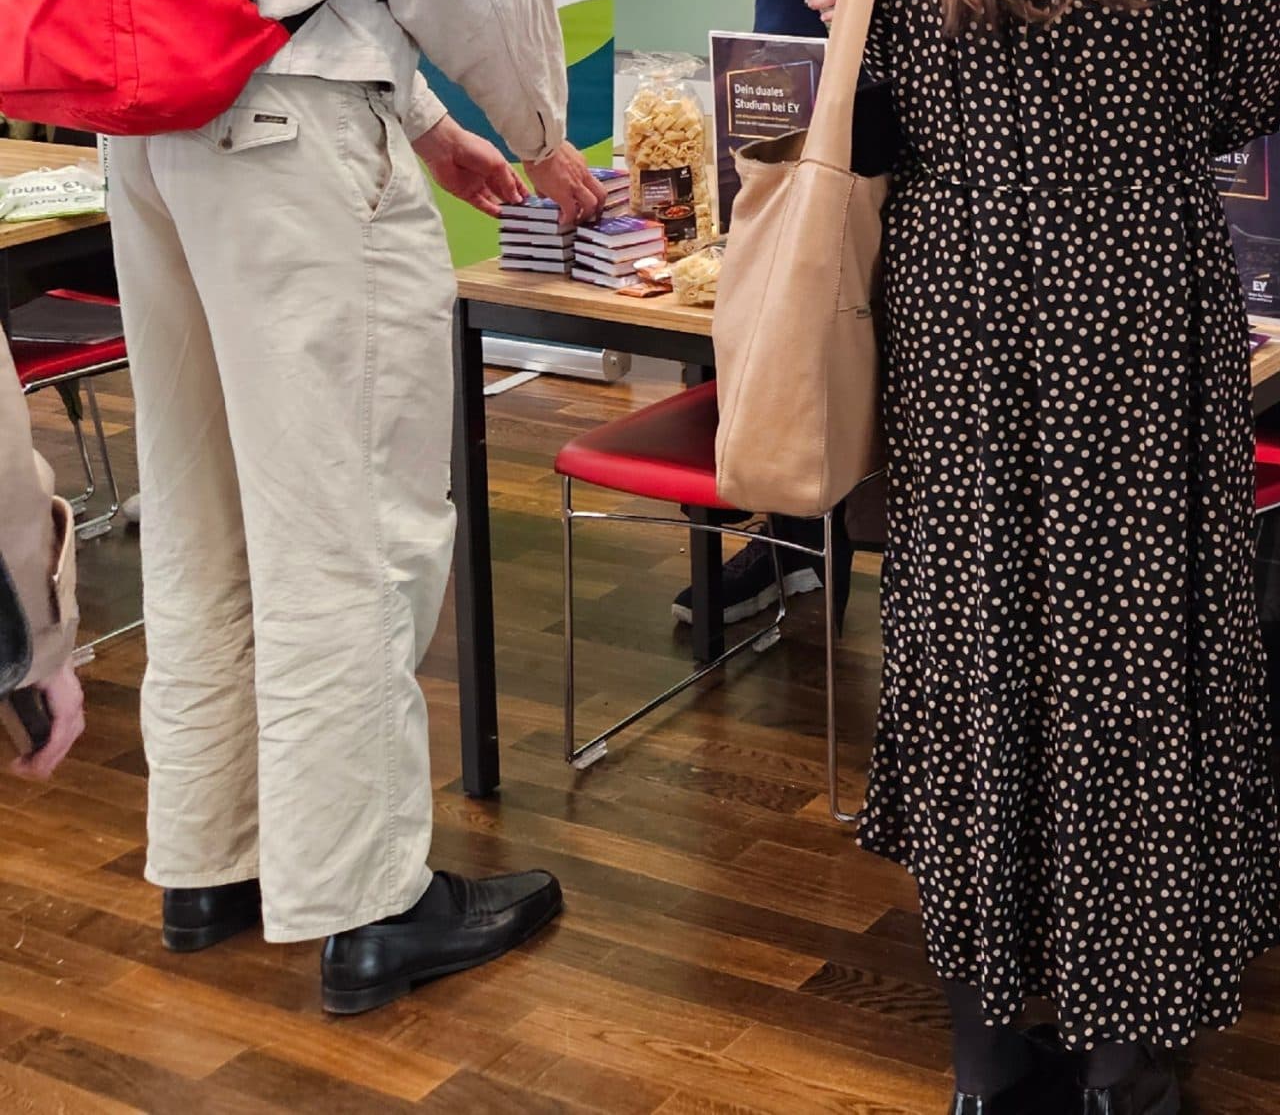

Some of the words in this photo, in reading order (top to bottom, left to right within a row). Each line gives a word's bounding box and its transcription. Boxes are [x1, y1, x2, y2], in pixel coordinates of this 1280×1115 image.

[733, 83, 755, 95] Dein
[755, 85, 784, 97] duales
[734, 99, 771, 112] Studium
[772, 102, 786, 113] bei
[787, 103, 800, 114] EY
[1234, 153, 1250, 165] EY
[1252, 280, 1268, 292] EY
